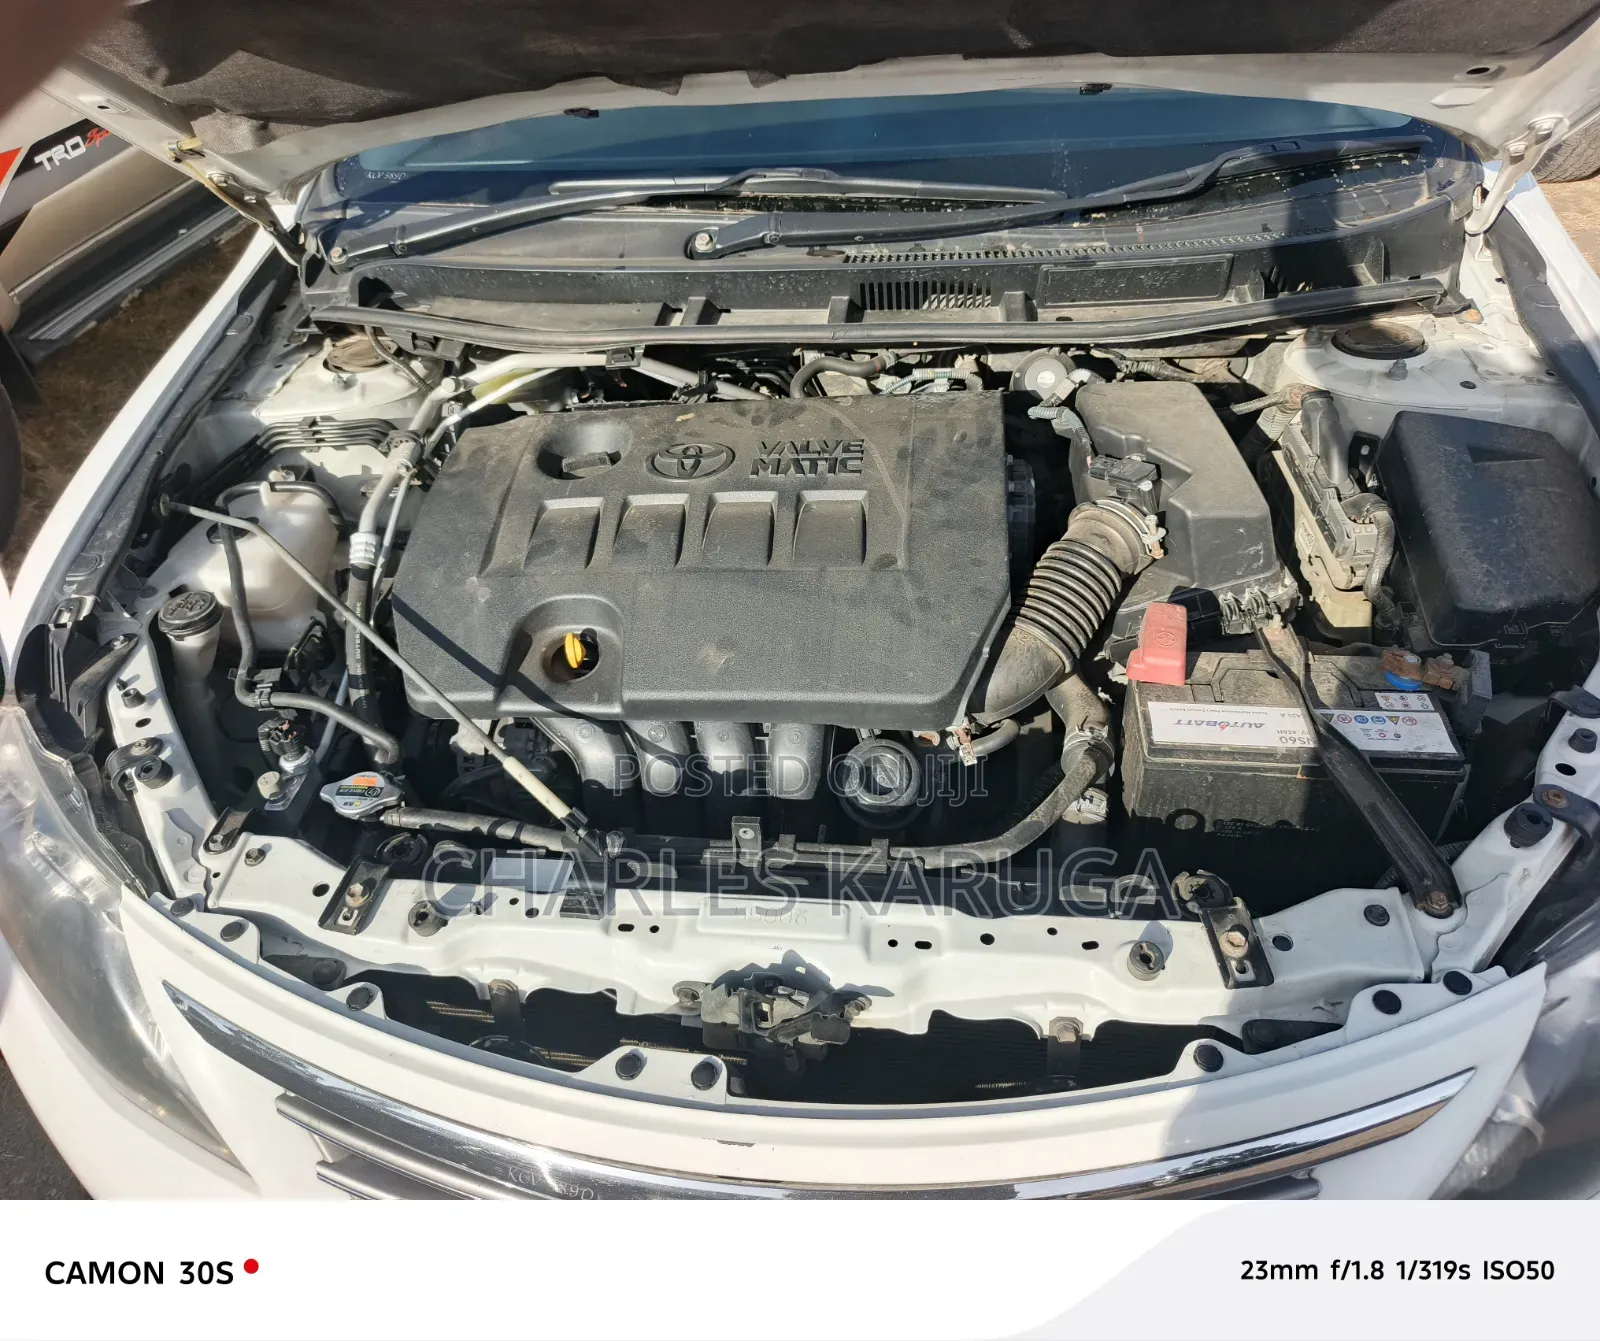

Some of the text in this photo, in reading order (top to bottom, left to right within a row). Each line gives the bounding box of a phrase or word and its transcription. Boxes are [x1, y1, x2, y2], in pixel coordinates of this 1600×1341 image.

[34, 135, 87, 171] TRD
[754, 439, 864, 457] VALVE
[749, 457, 864, 478] MATIC
[1173, 719, 1266, 730] AUTOBATT
